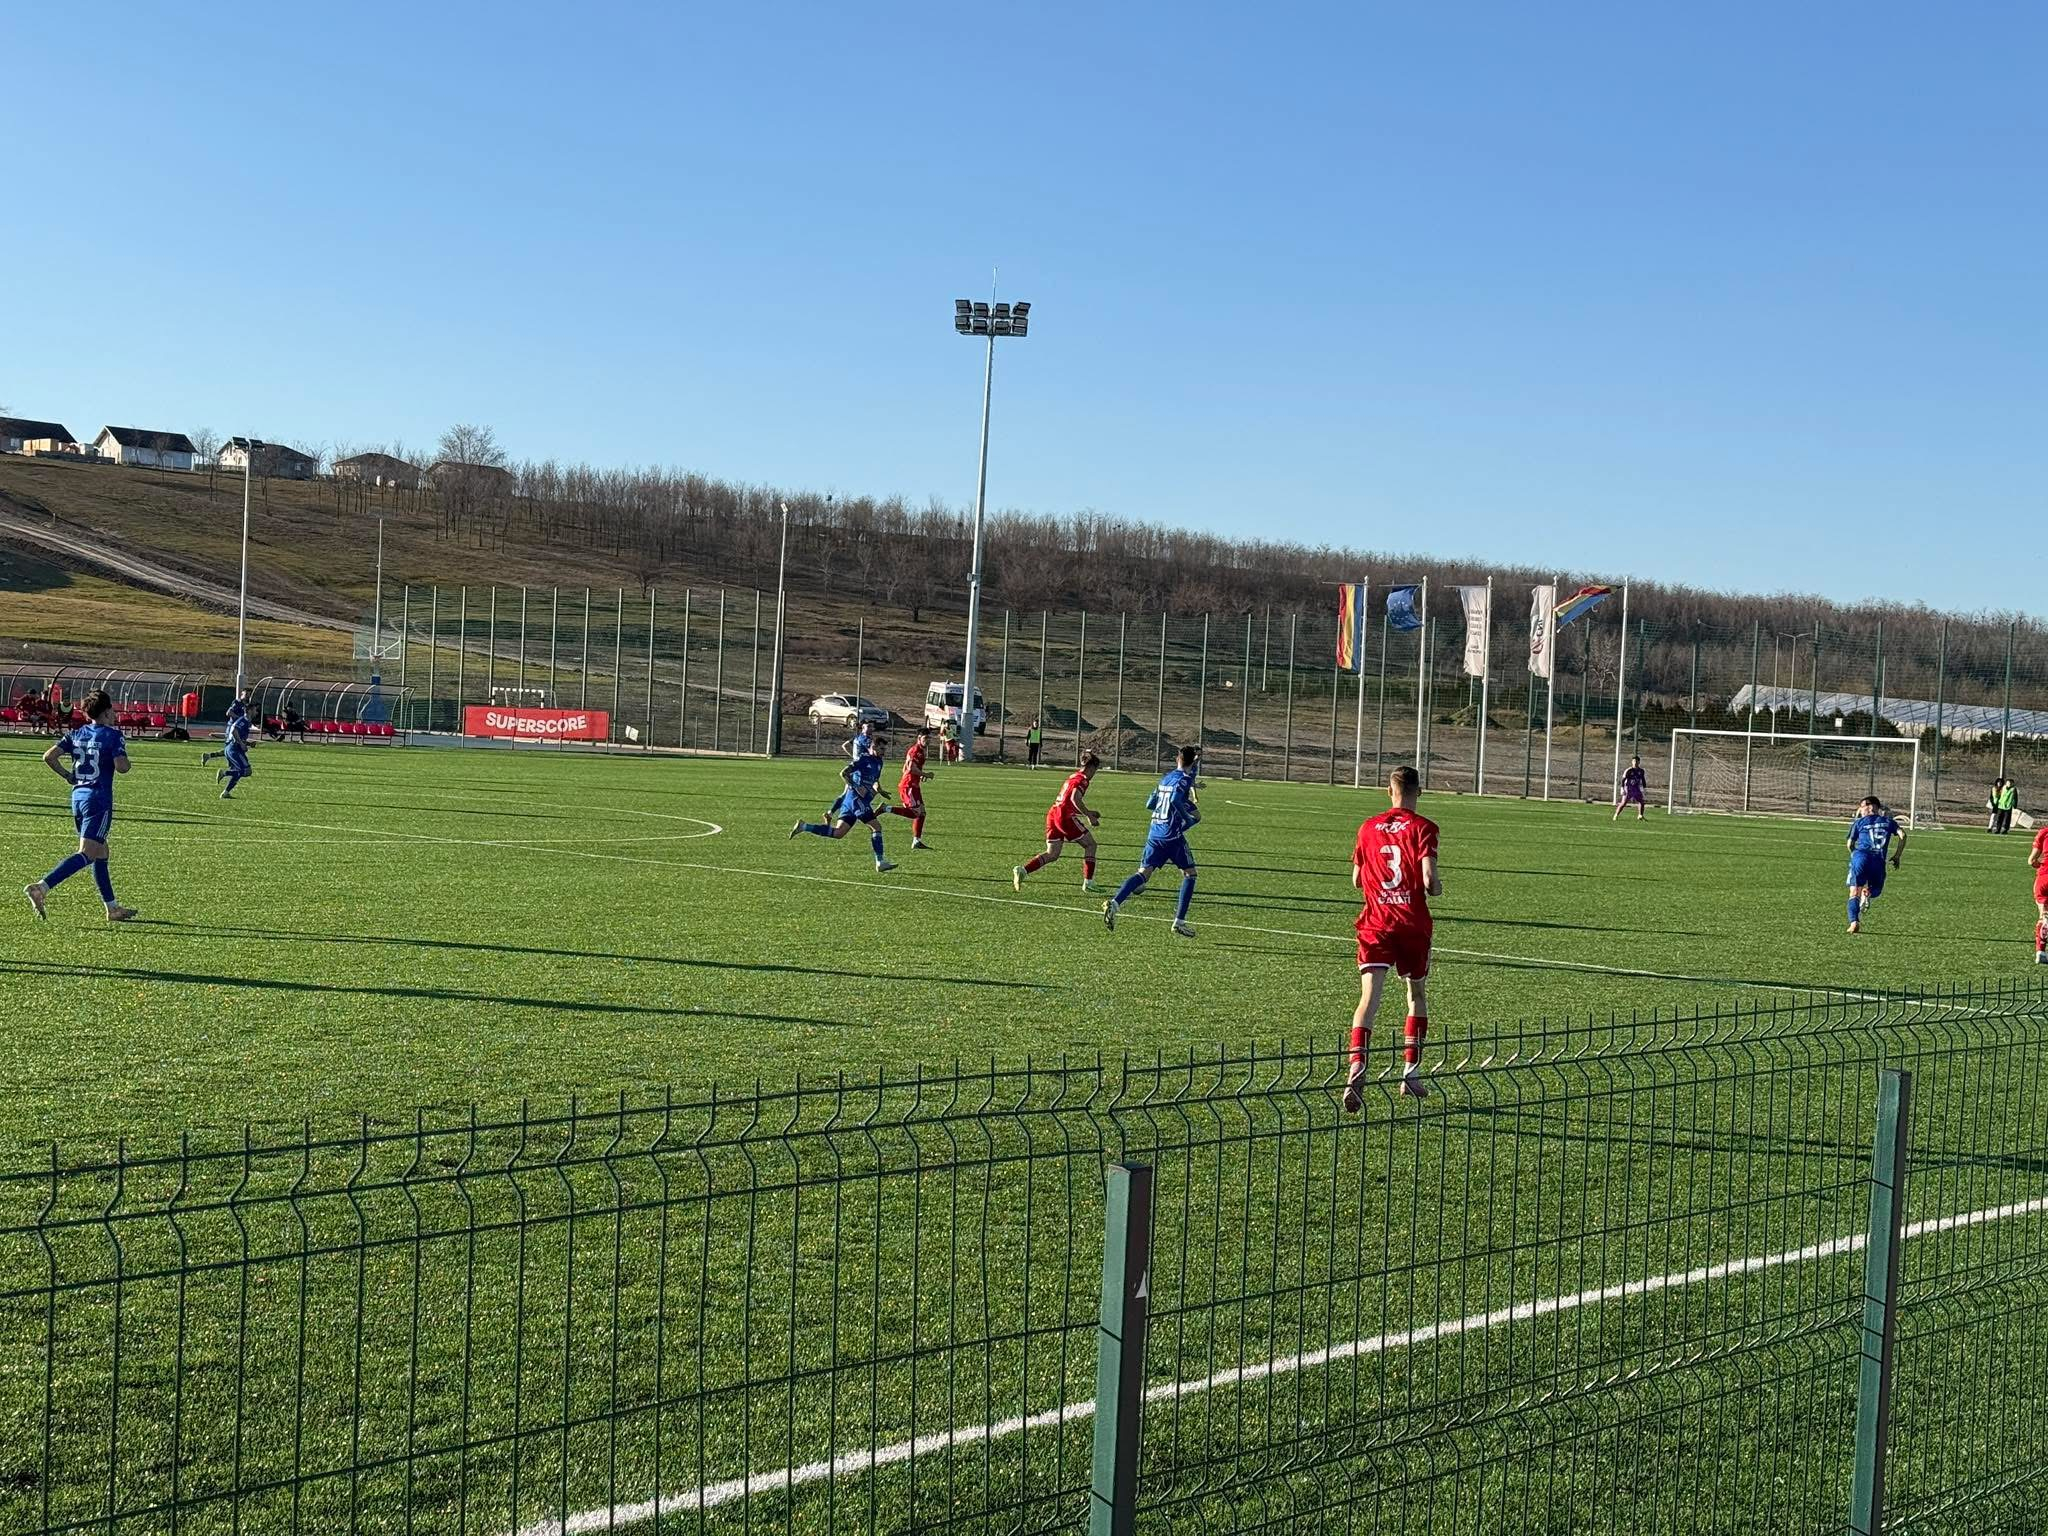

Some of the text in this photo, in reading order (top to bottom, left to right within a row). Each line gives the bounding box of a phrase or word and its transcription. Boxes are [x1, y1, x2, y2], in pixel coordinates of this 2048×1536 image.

[485, 711, 588, 734] SUPERSCORE
[73, 747, 100, 781] 23
[1868, 828, 1887, 850] 15
[1379, 844, 1403, 889] 3
